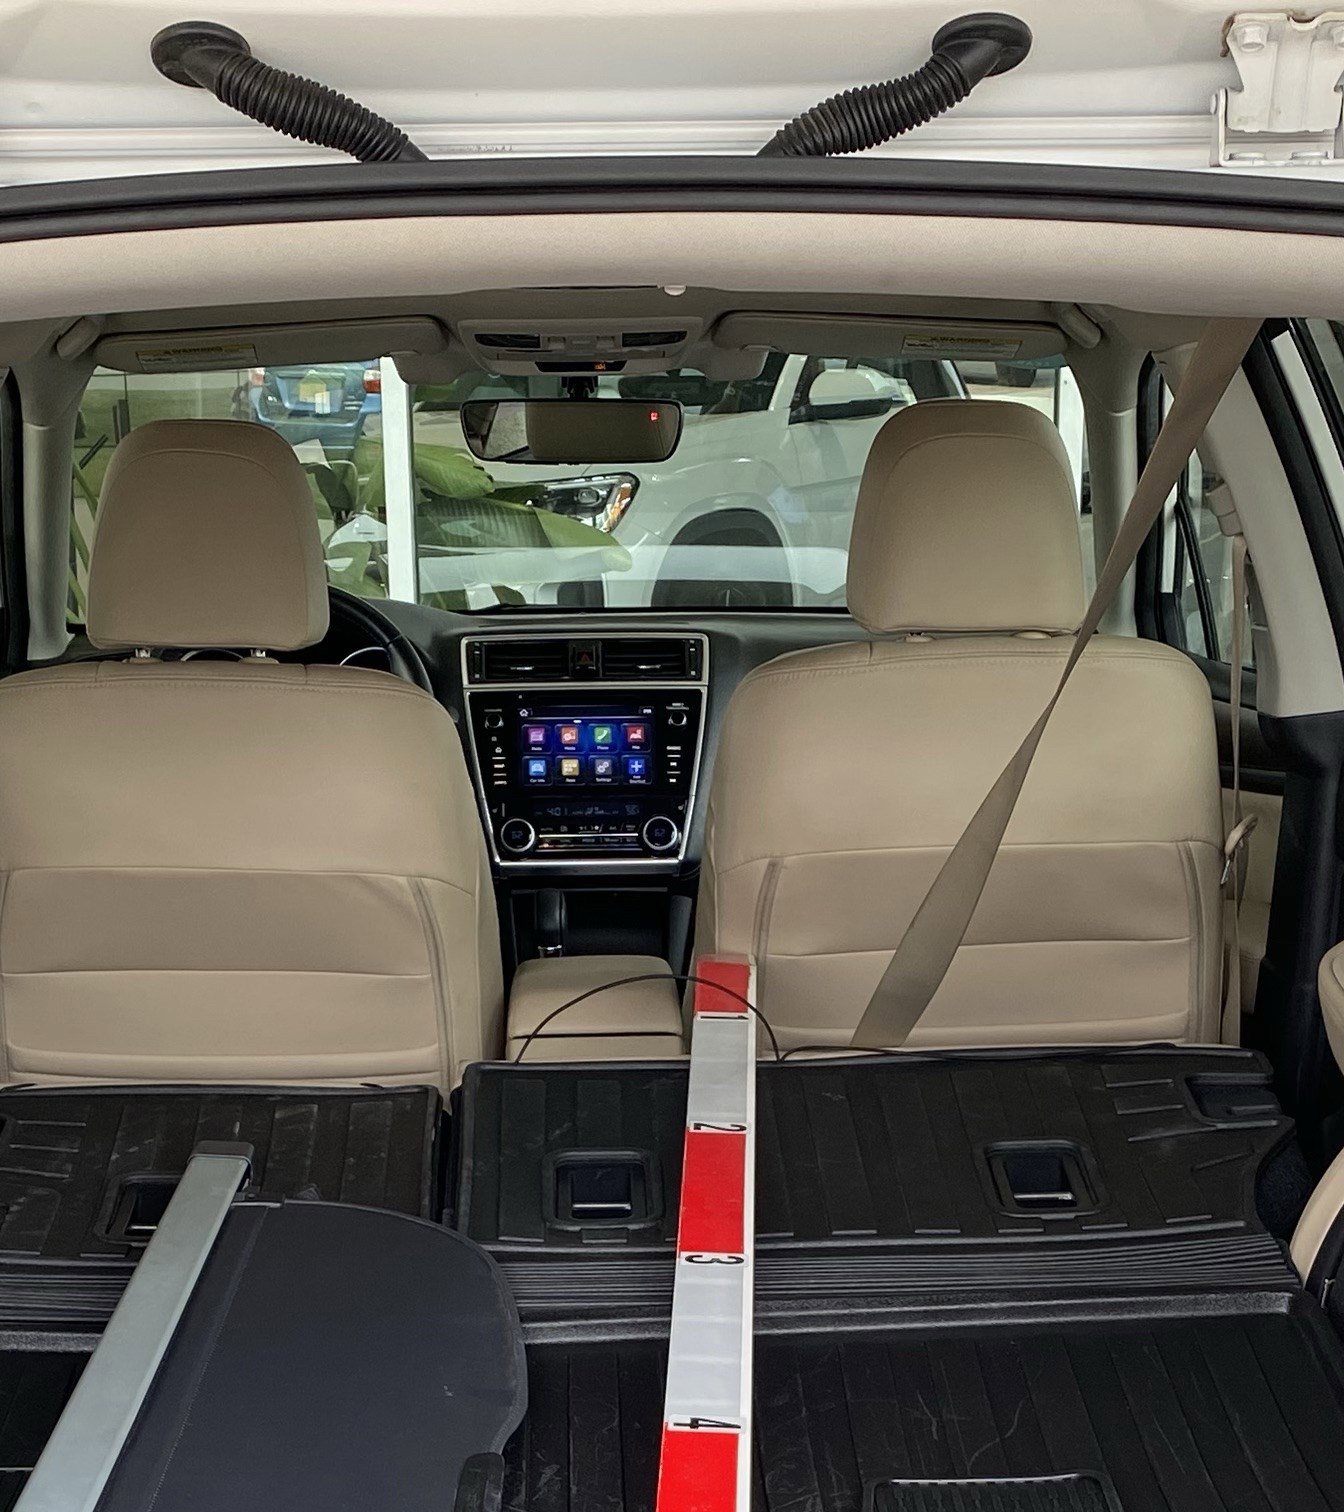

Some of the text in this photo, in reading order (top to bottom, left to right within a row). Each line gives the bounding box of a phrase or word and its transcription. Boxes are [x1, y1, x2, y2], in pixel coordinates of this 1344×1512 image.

[693, 1122, 747, 1131] 2
[684, 1254, 745, 1265] 3
[673, 1416, 742, 1430] 4
